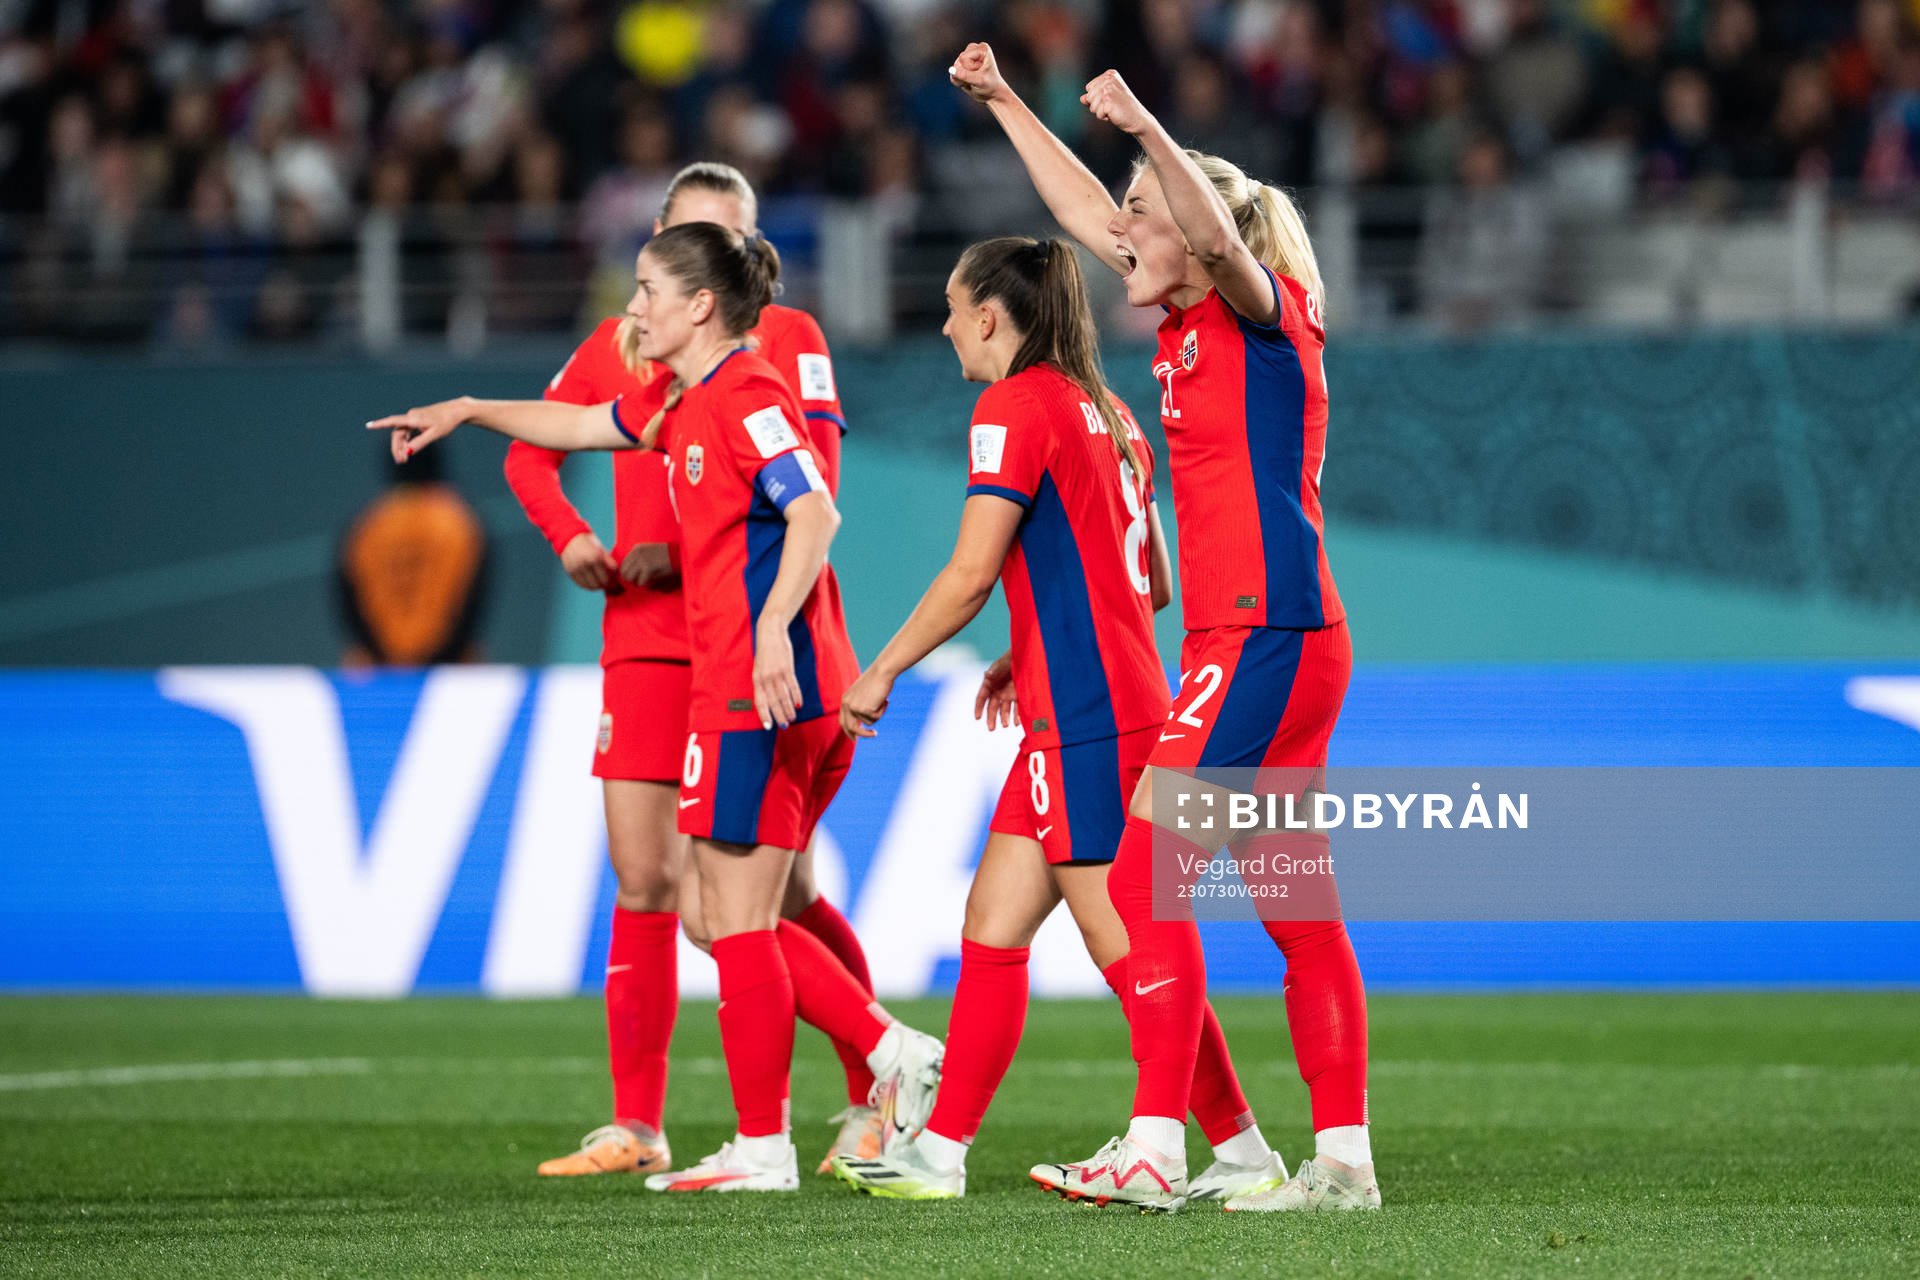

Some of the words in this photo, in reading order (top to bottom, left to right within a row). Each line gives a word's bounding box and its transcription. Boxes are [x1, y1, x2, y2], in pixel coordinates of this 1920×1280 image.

[1119, 458, 1151, 596] 8
[1167, 664, 1224, 729] 2
[682, 731, 704, 788] 6
[1028, 750, 1050, 816] 8
